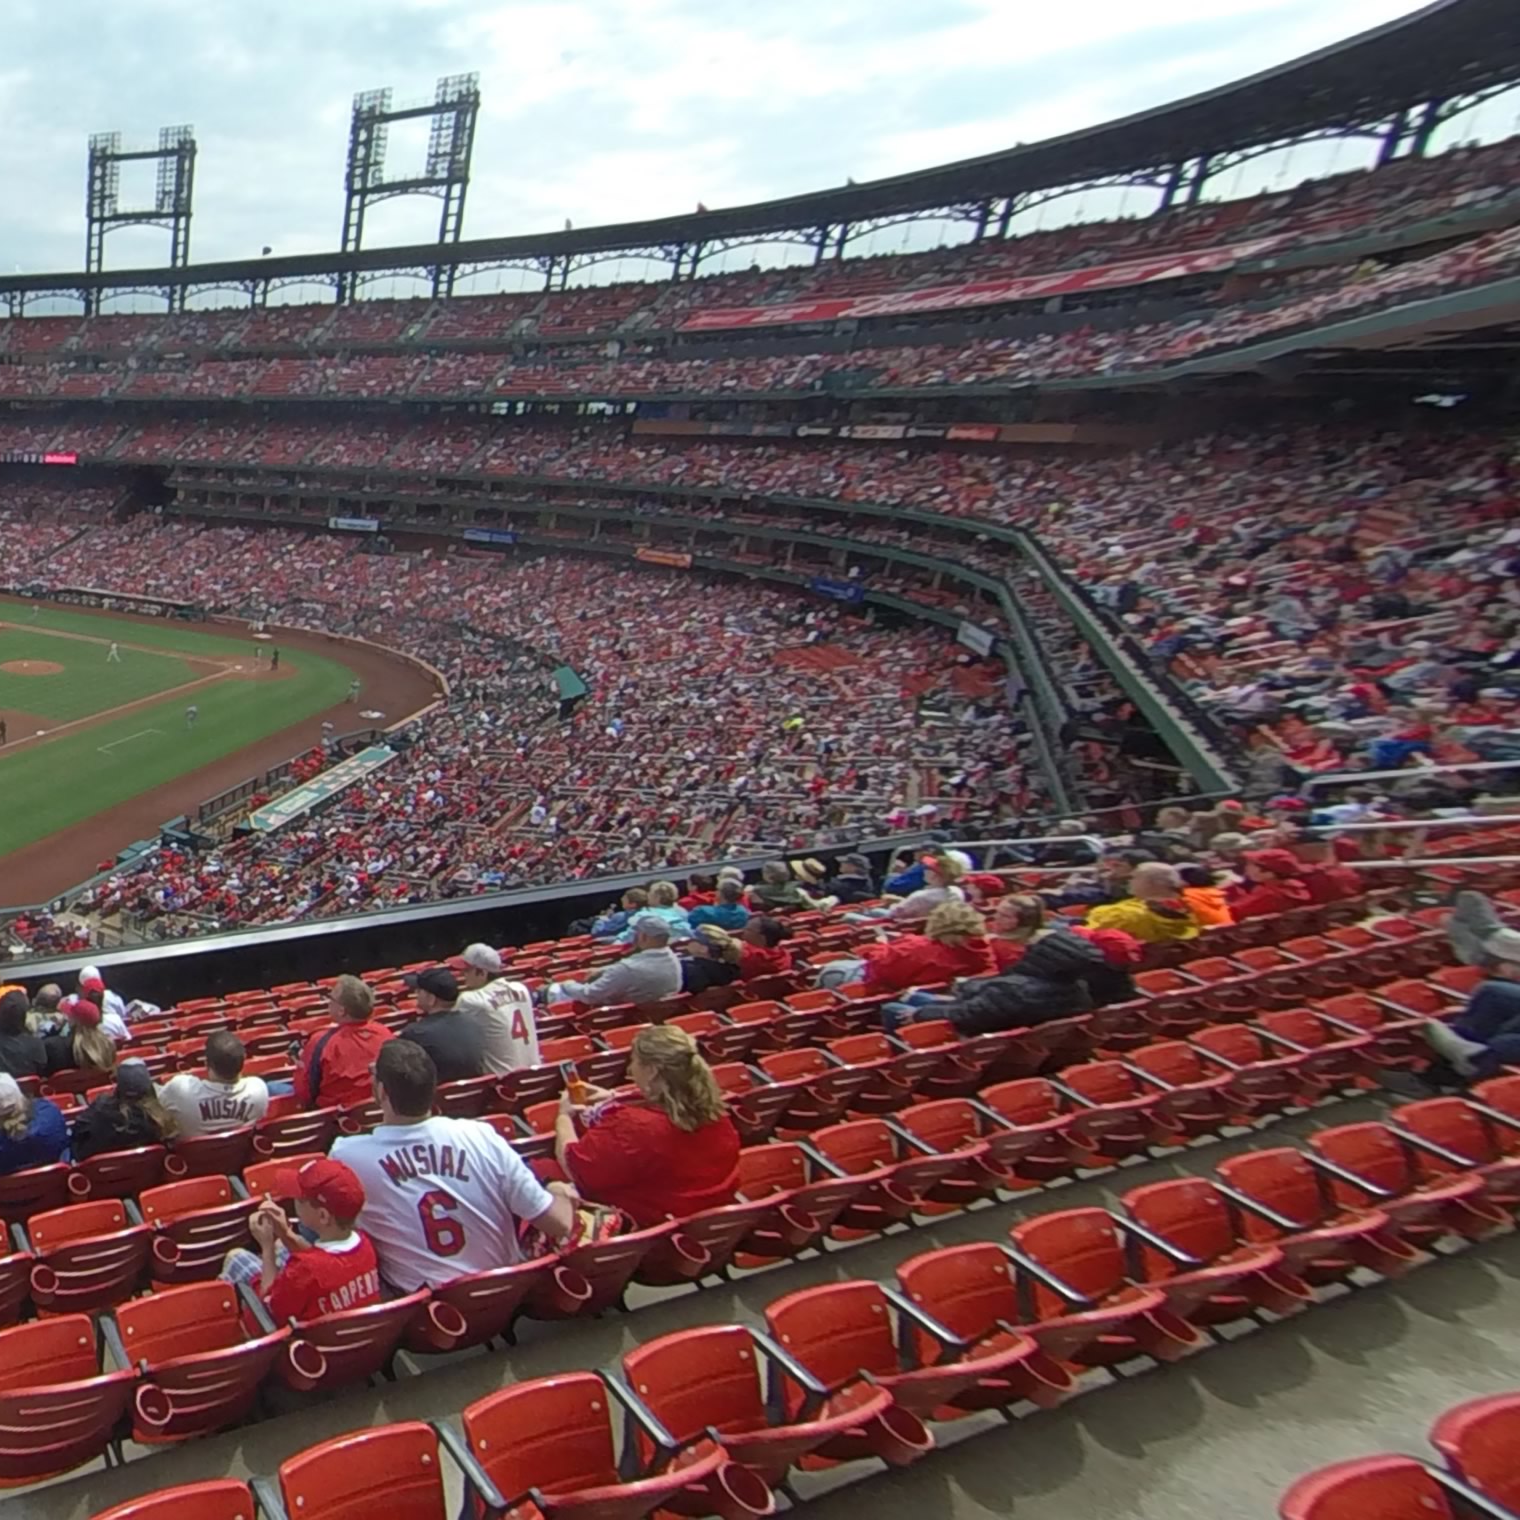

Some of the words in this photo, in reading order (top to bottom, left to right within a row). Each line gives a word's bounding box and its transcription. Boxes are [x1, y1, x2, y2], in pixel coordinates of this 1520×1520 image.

[511, 1008, 530, 1045] 4
[198, 1098, 254, 1122] MUSIAL
[378, 1143, 469, 1187] MUSIAL
[417, 1189, 466, 1257] 6
